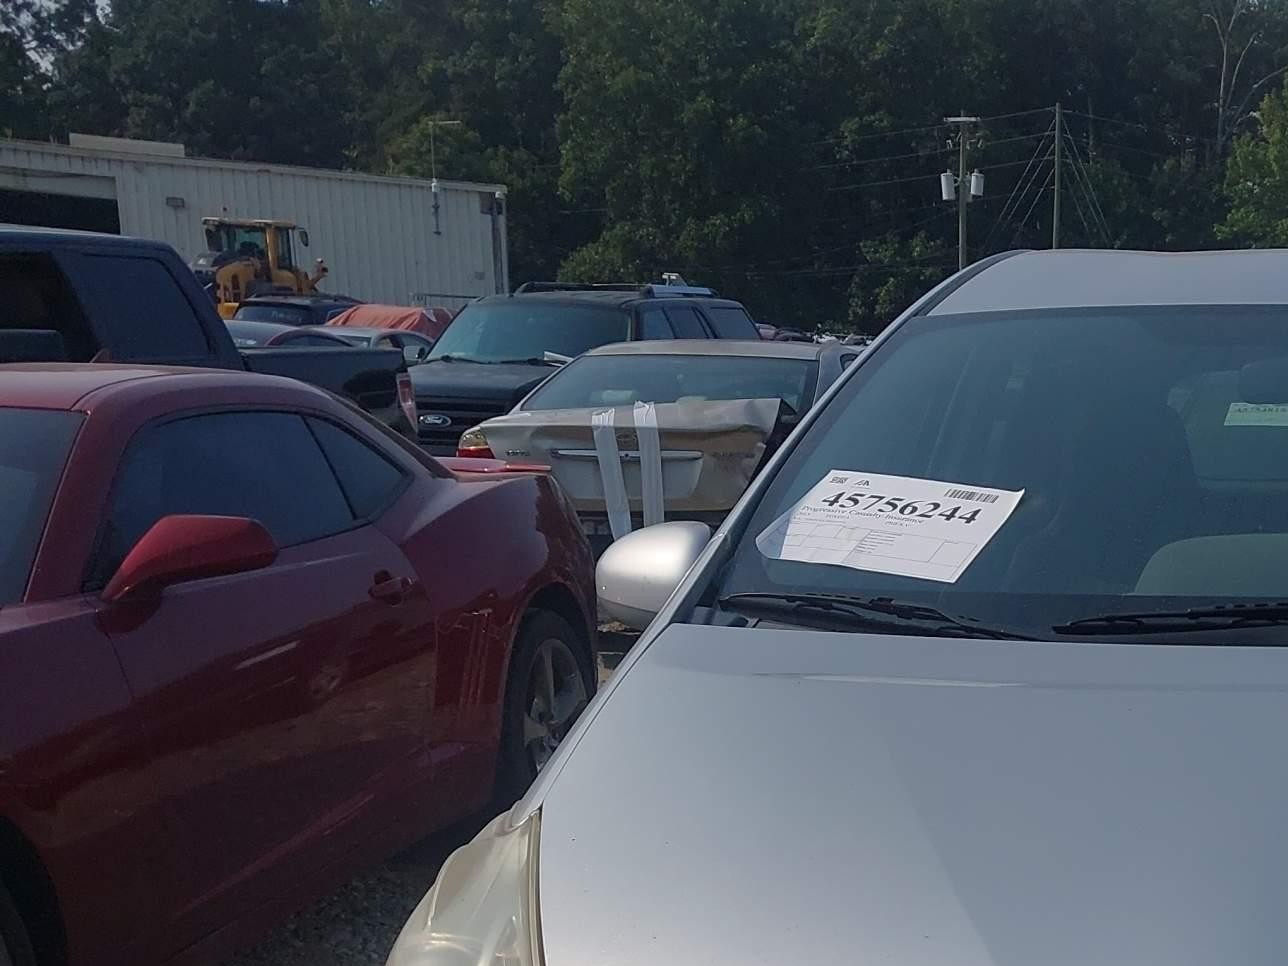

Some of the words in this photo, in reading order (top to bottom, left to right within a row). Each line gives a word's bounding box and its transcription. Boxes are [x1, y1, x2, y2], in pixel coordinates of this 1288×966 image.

[801, 505, 847, 515] Progressive
[848, 509, 883, 519] Casualty
[884, 513, 925, 524] Insurance
[822, 490, 982, 524] 45756244
